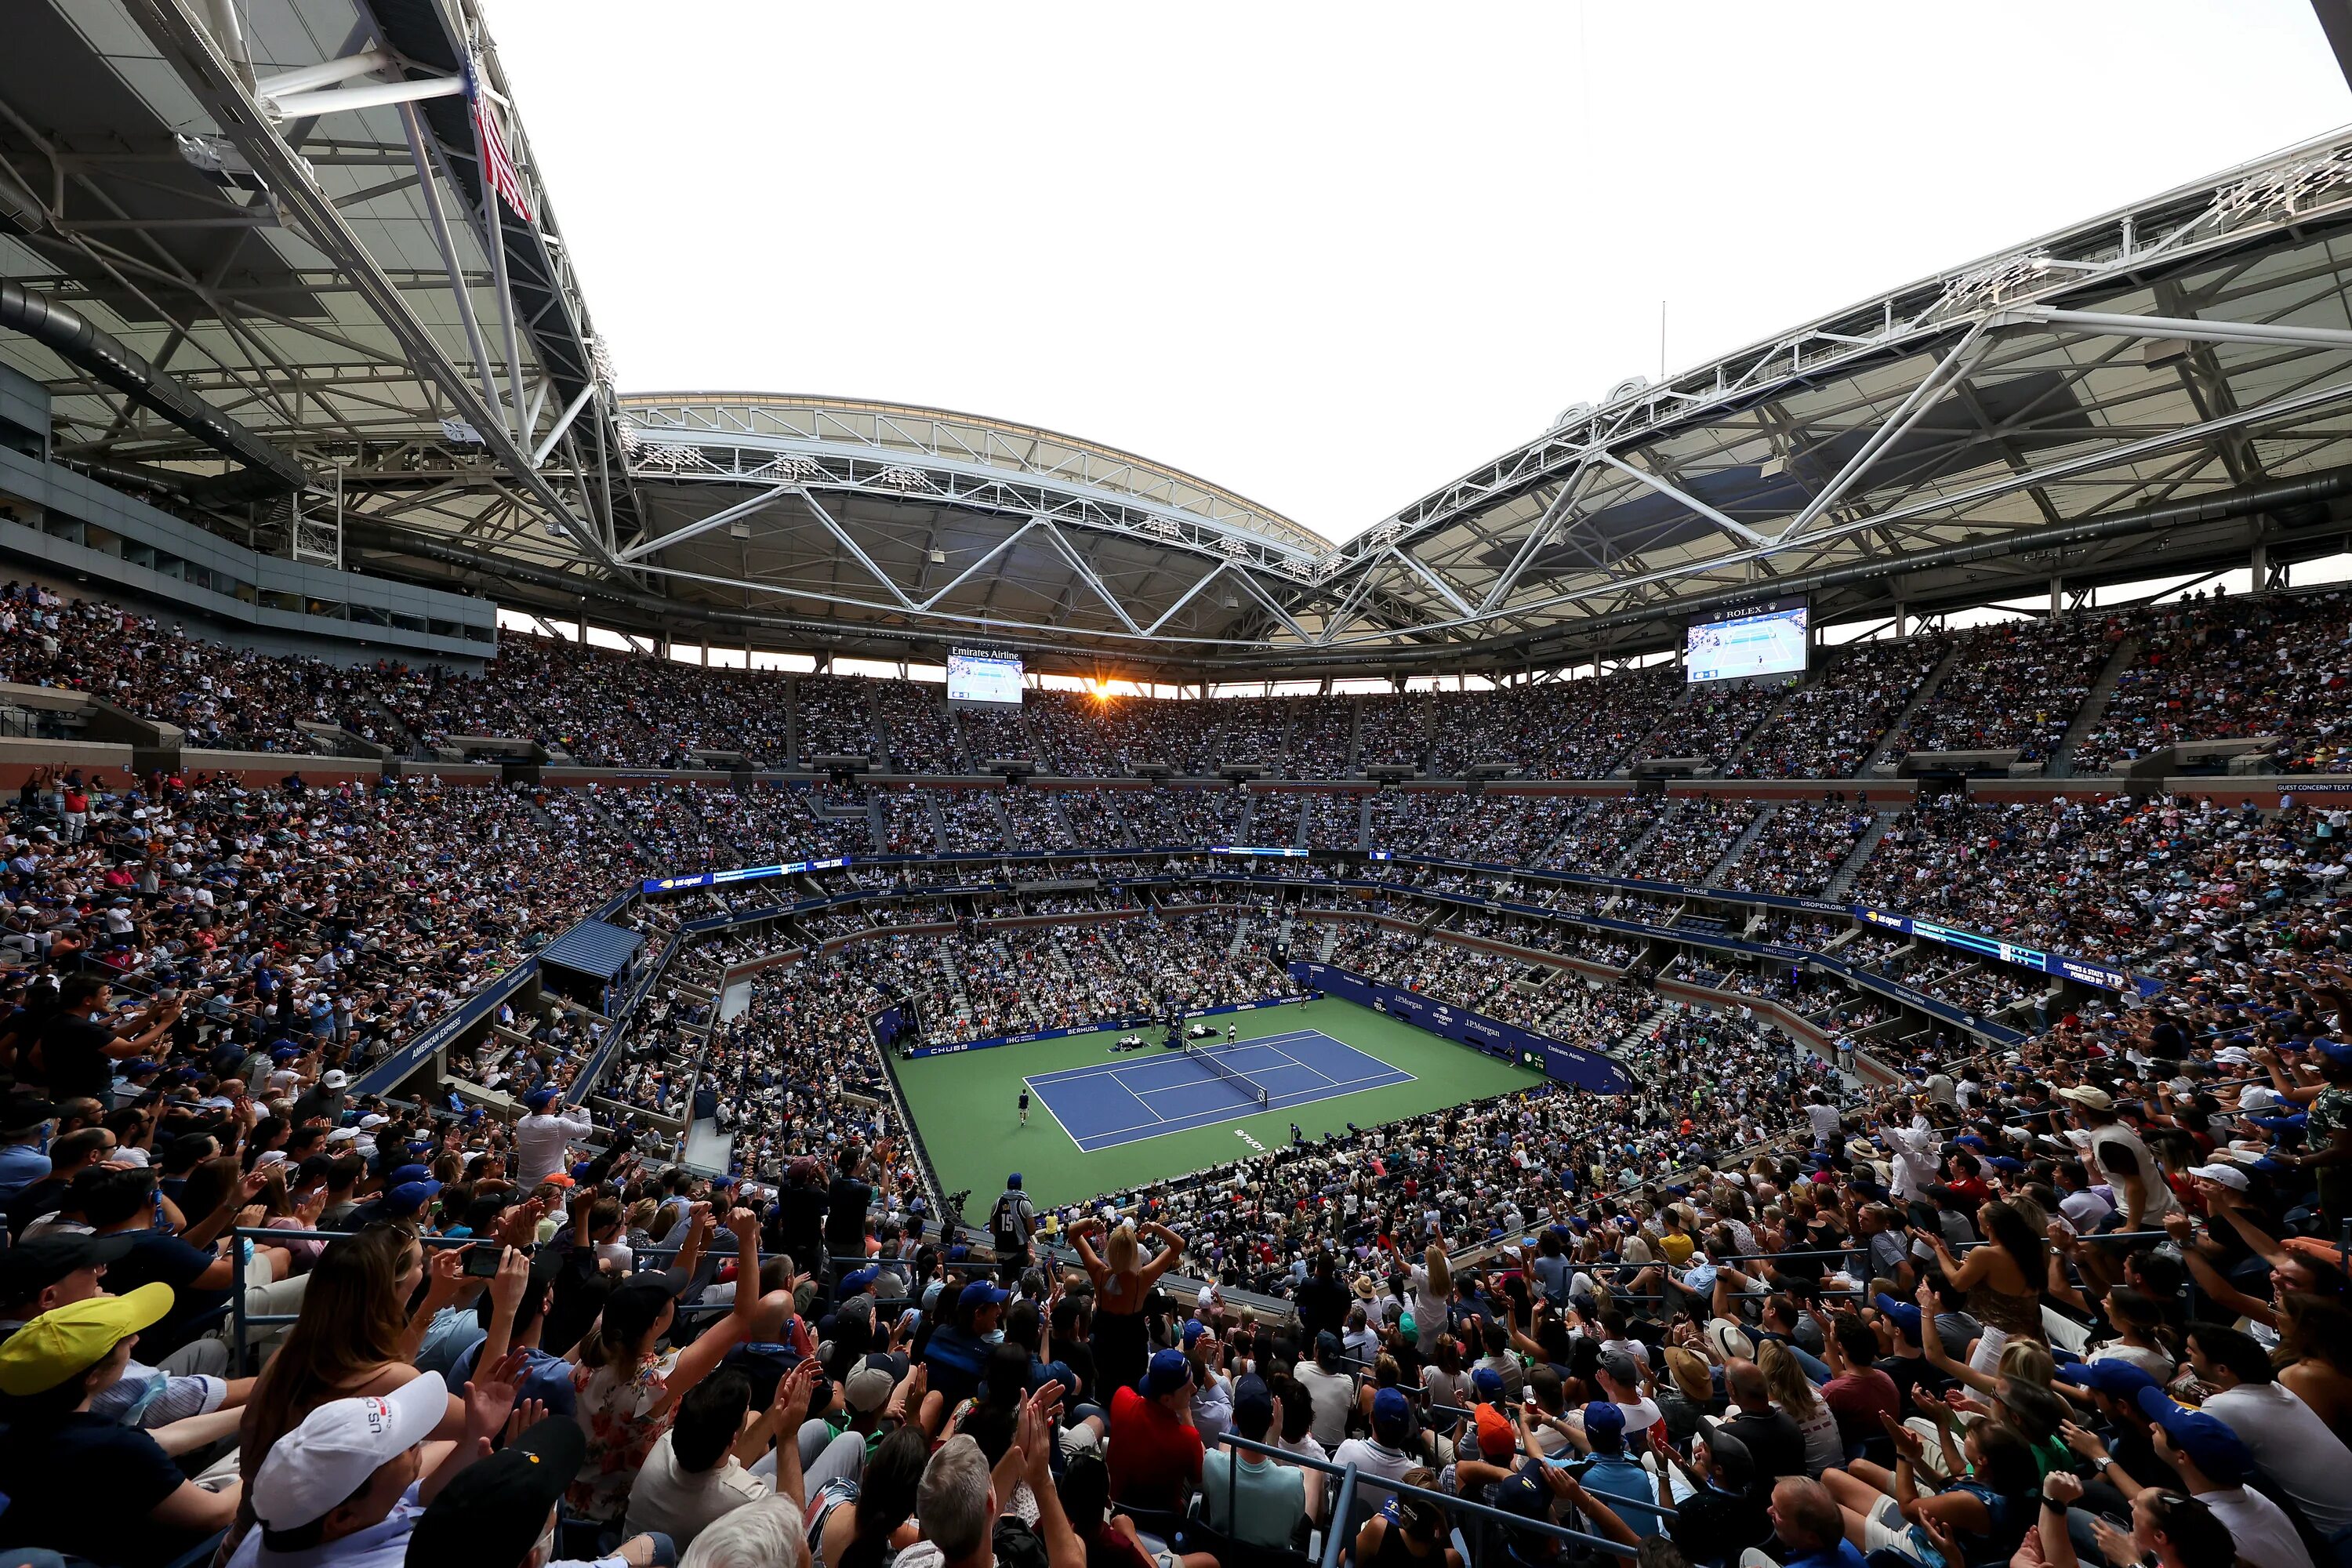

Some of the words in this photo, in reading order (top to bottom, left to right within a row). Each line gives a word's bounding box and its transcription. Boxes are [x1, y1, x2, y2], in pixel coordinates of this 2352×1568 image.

[1726, 606, 1762, 619] ROLEX
[952, 646, 989, 657] Emirates
[991, 650, 1019, 660] Airline
[684, 877, 702, 887] open
[1683, 887, 1709, 895] CHASE
[1800, 901, 1846, 911] USOPEN.ORG
[1885, 918, 1901, 927] open
[2063, 962, 2082, 973] SCORES
[2087, 968, 2104, 978] STATS
[2070, 971, 2095, 983] POWERED
[1394, 995, 1422, 1010] J.P.Morgan
[1895, 988, 1911, 999] Emirates
[1912, 994, 1925, 1005] Airline
[1439, 1014, 1452, 1023] open
[1067, 1026, 1098, 1035] BERMUDA
[1465, 1019, 1500, 1037] J.P.Morgan
[412, 1032, 439, 1060] AMERICAN
[440, 1016, 461, 1038] EXPRESS
[931, 1044, 968, 1054] CHUBB
[1548, 1045, 1568, 1056] Emirates
[1569, 1052, 1586, 1062] Airline
[1234, 1129, 1266, 1151] 9/11/01
[1001, 1214, 1013, 1231] 15
[368, 1413, 382, 1433] US
